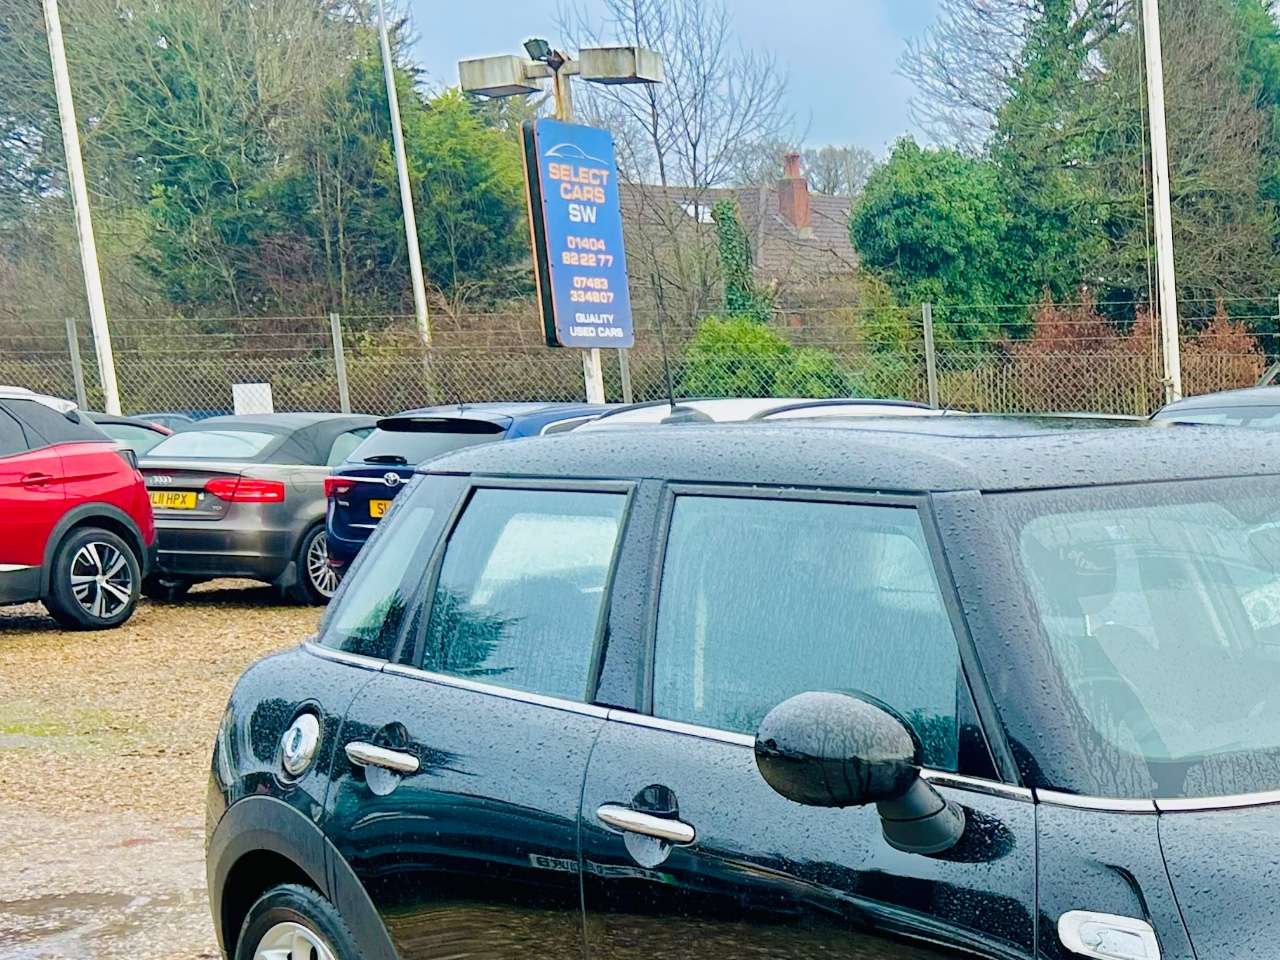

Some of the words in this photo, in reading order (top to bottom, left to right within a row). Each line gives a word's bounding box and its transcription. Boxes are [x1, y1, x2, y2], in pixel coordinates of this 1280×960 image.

[548, 162, 609, 186] SELECT
[560, 182, 606, 204] CARS
[568, 203, 597, 224] SW
[567, 236, 606, 251] 01404
[562, 251, 579, 265] 82
[579, 253, 597, 267] 22
[598, 254, 613, 268] 77
[575, 313, 614, 324] QUALITY
[569, 326, 596, 337] USED
[598, 327, 624, 338] CARS
[166, 492, 187, 505] HPX
